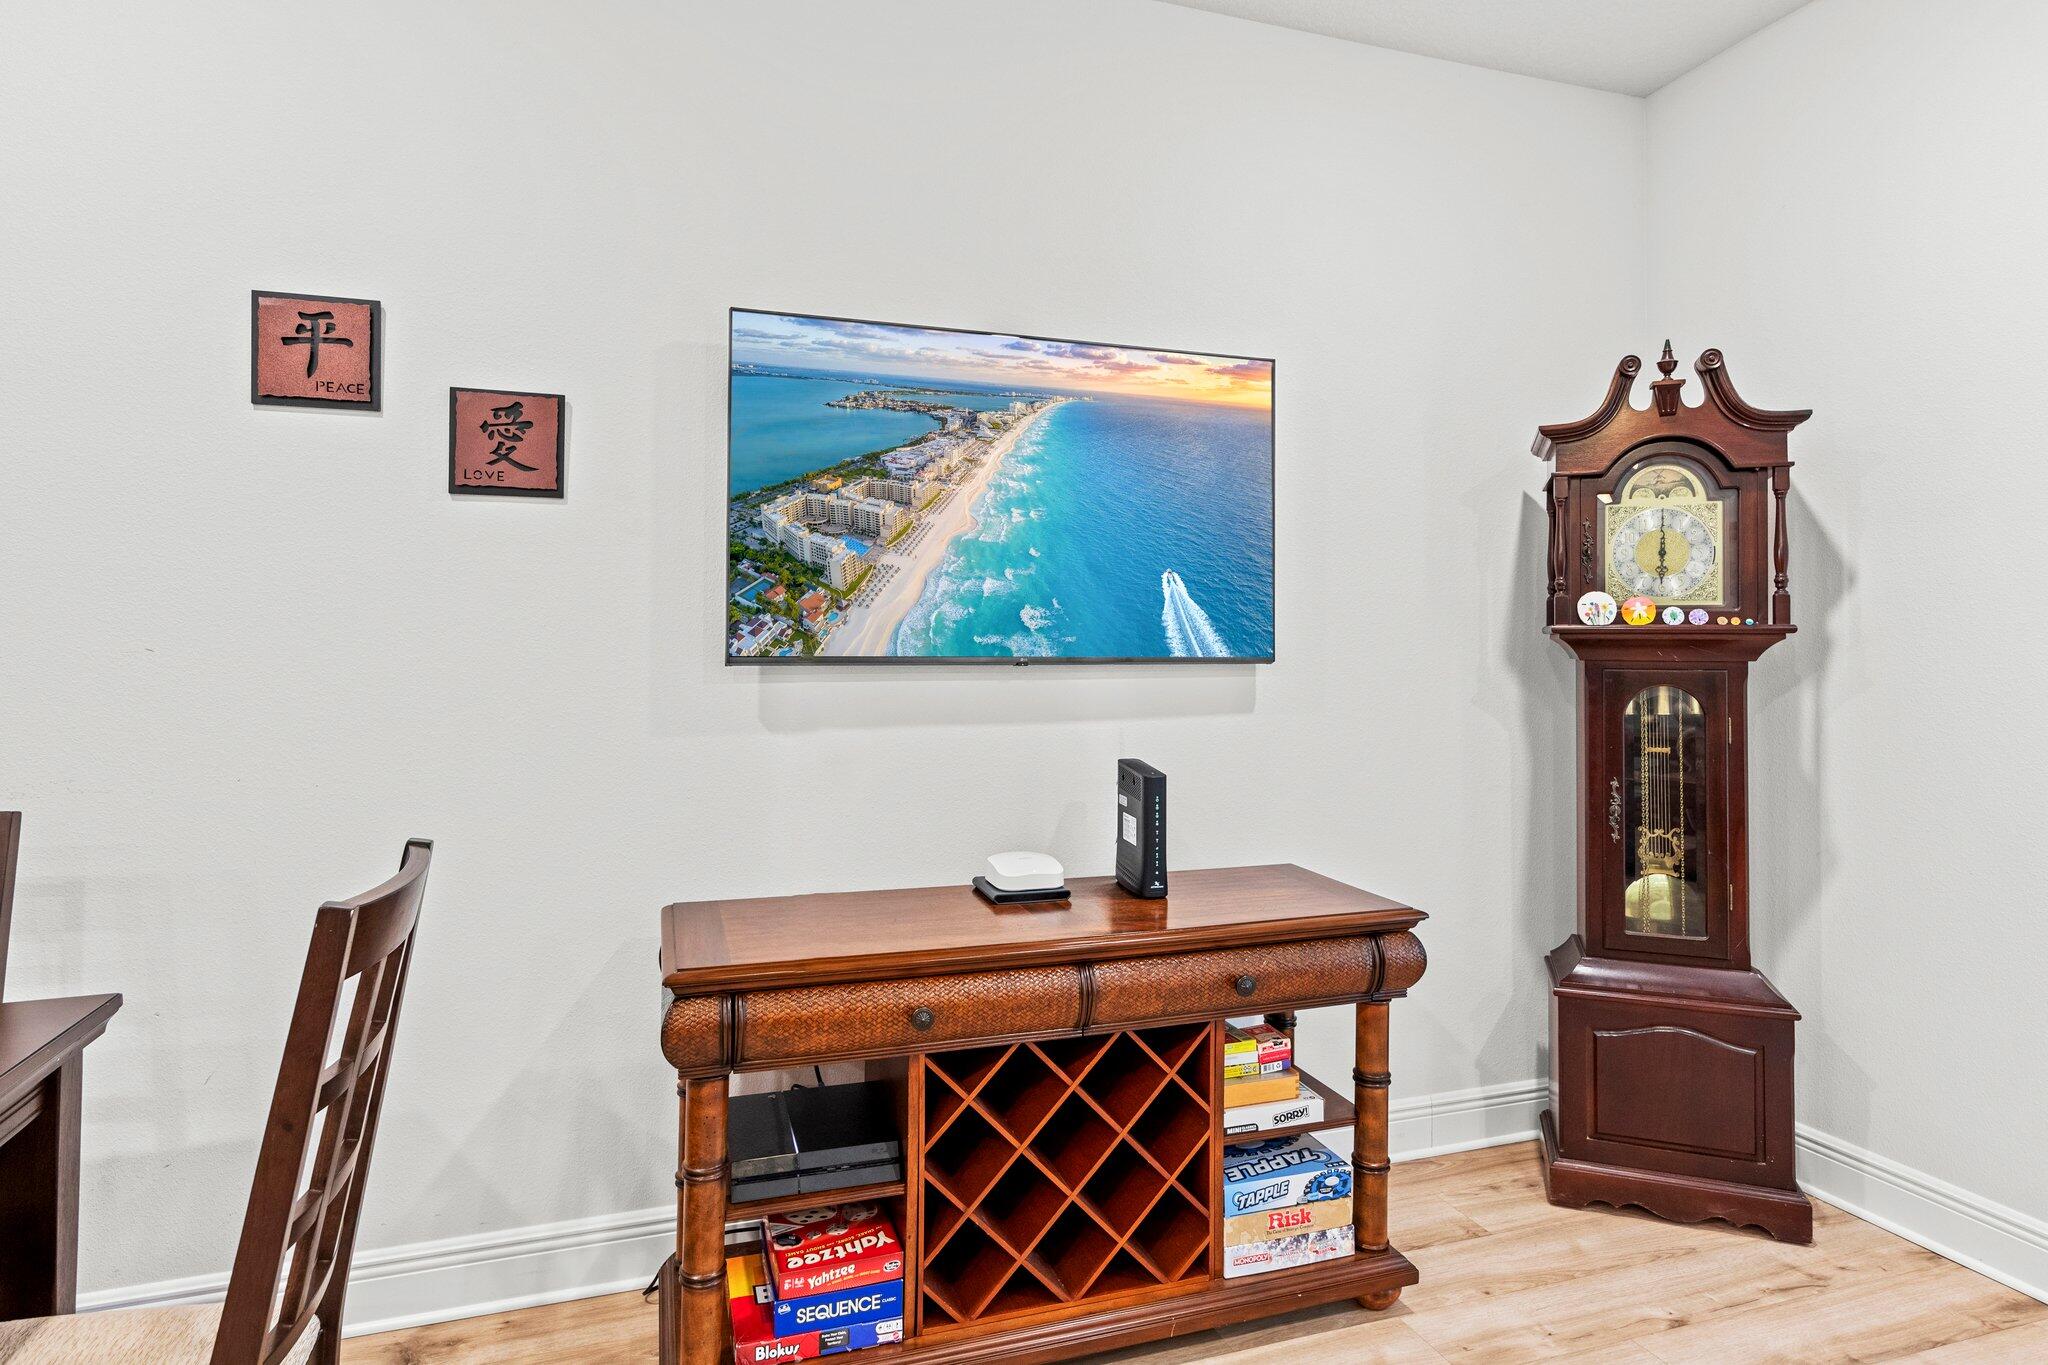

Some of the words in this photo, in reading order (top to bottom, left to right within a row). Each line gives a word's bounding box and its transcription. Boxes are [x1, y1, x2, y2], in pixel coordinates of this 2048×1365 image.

[280, 311, 354, 379] 平
[315, 380, 365, 395] PEACE
[479, 401, 539, 472] 愛
[463, 468, 505, 482] LOVE
[1273, 1107, 1309, 1125] SORRY!
[1226, 1127, 1242, 1135] MINI
[1225, 1149, 1319, 1182] TAPPLE
[1237, 1180, 1290, 1211] TAPPLE
[1268, 1208, 1312, 1230] Risk
[787, 1231, 895, 1269] Yahtzee
[1233, 1253, 1268, 1266] MONOPOLY
[807, 1263, 856, 1290] Yahtzee
[796, 1294, 881, 1324] SEQUENCE
[755, 1343, 800, 1362] Blokus
